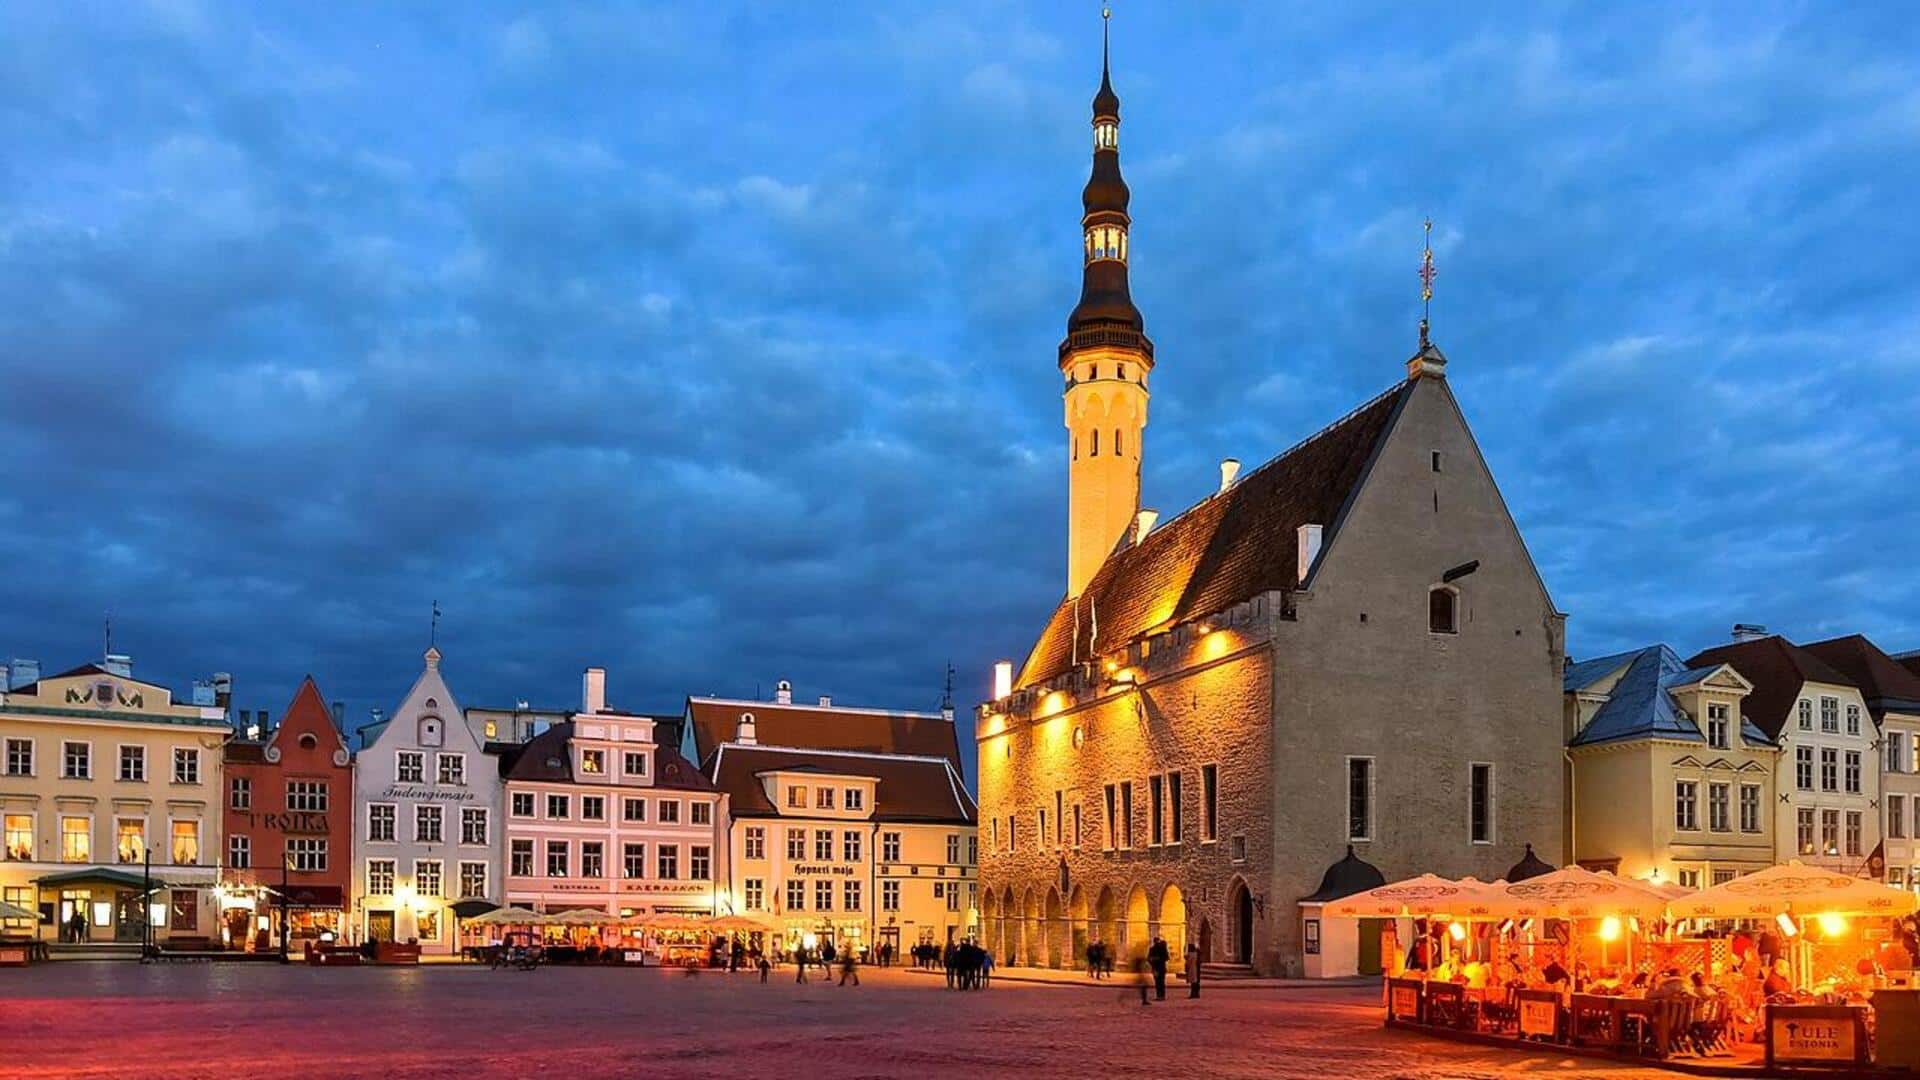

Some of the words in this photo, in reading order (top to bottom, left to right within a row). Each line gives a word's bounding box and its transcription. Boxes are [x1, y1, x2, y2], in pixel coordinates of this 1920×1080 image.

[246, 812, 330, 832] TROIKA
[832, 866, 854, 876] maja
[626, 884, 704, 892] KAERAJAAN
[1785, 1023, 1840, 1039] TULE
[1789, 1040, 1840, 1049] ESTONIA
